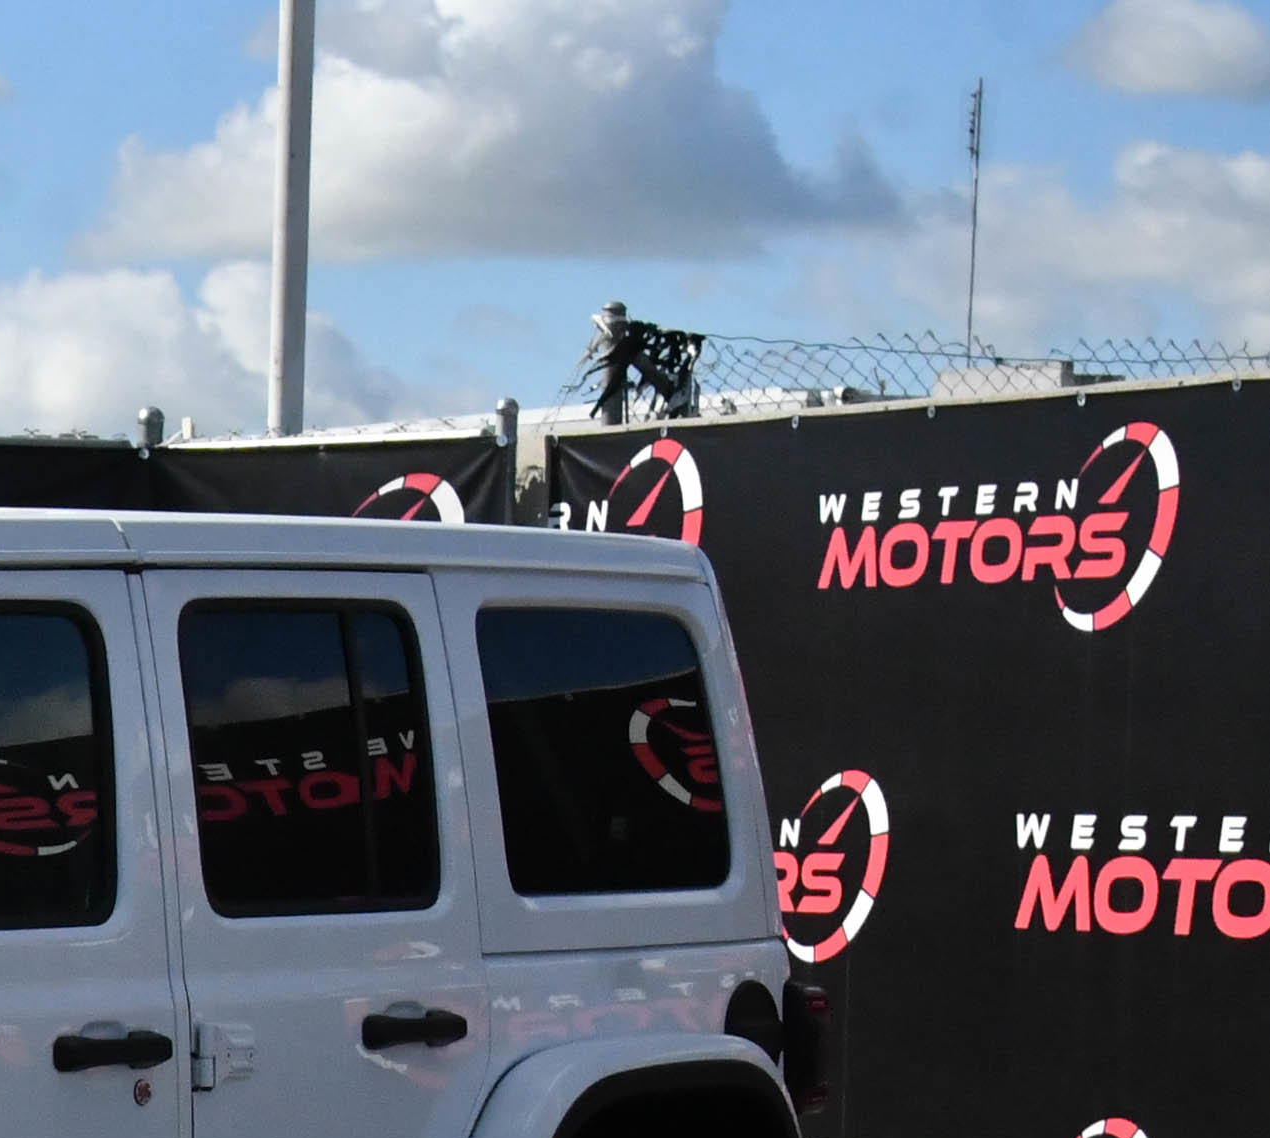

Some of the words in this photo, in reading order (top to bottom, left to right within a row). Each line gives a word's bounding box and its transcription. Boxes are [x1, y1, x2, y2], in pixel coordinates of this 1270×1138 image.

[819, 477, 1079, 524] WESTERN
[817, 512, 1130, 590] MOTORS
[1016, 812, 1270, 854] WESTE
[1014, 853, 1270, 940] MOTO
